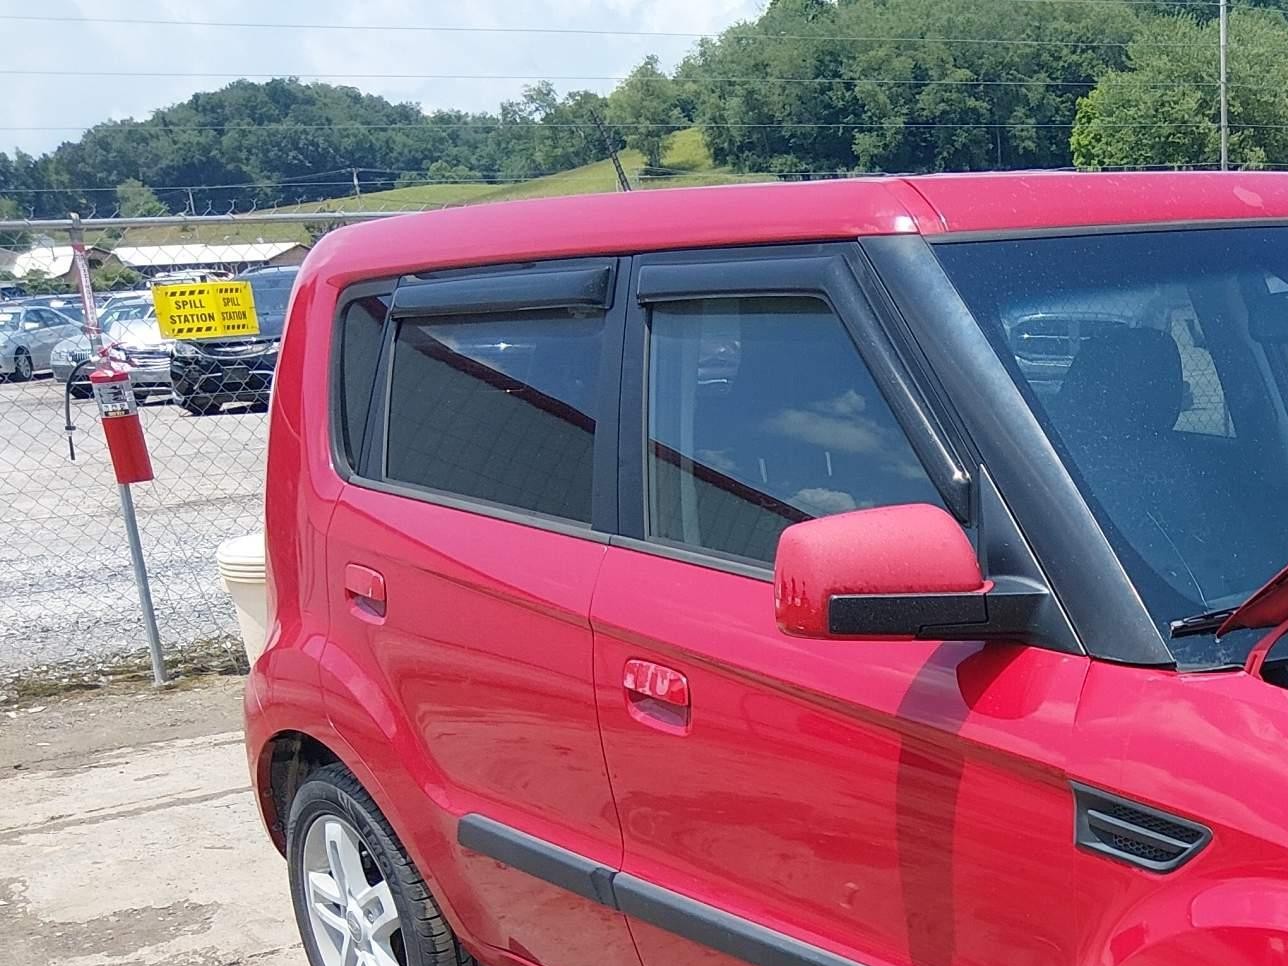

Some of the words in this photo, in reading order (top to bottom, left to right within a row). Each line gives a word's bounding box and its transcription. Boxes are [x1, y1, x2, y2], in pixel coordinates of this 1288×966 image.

[173, 299, 206, 310] SPILL
[222, 297, 241, 307] SPILL
[169, 312, 215, 324] STATION
[221, 310, 248, 321] STATION
